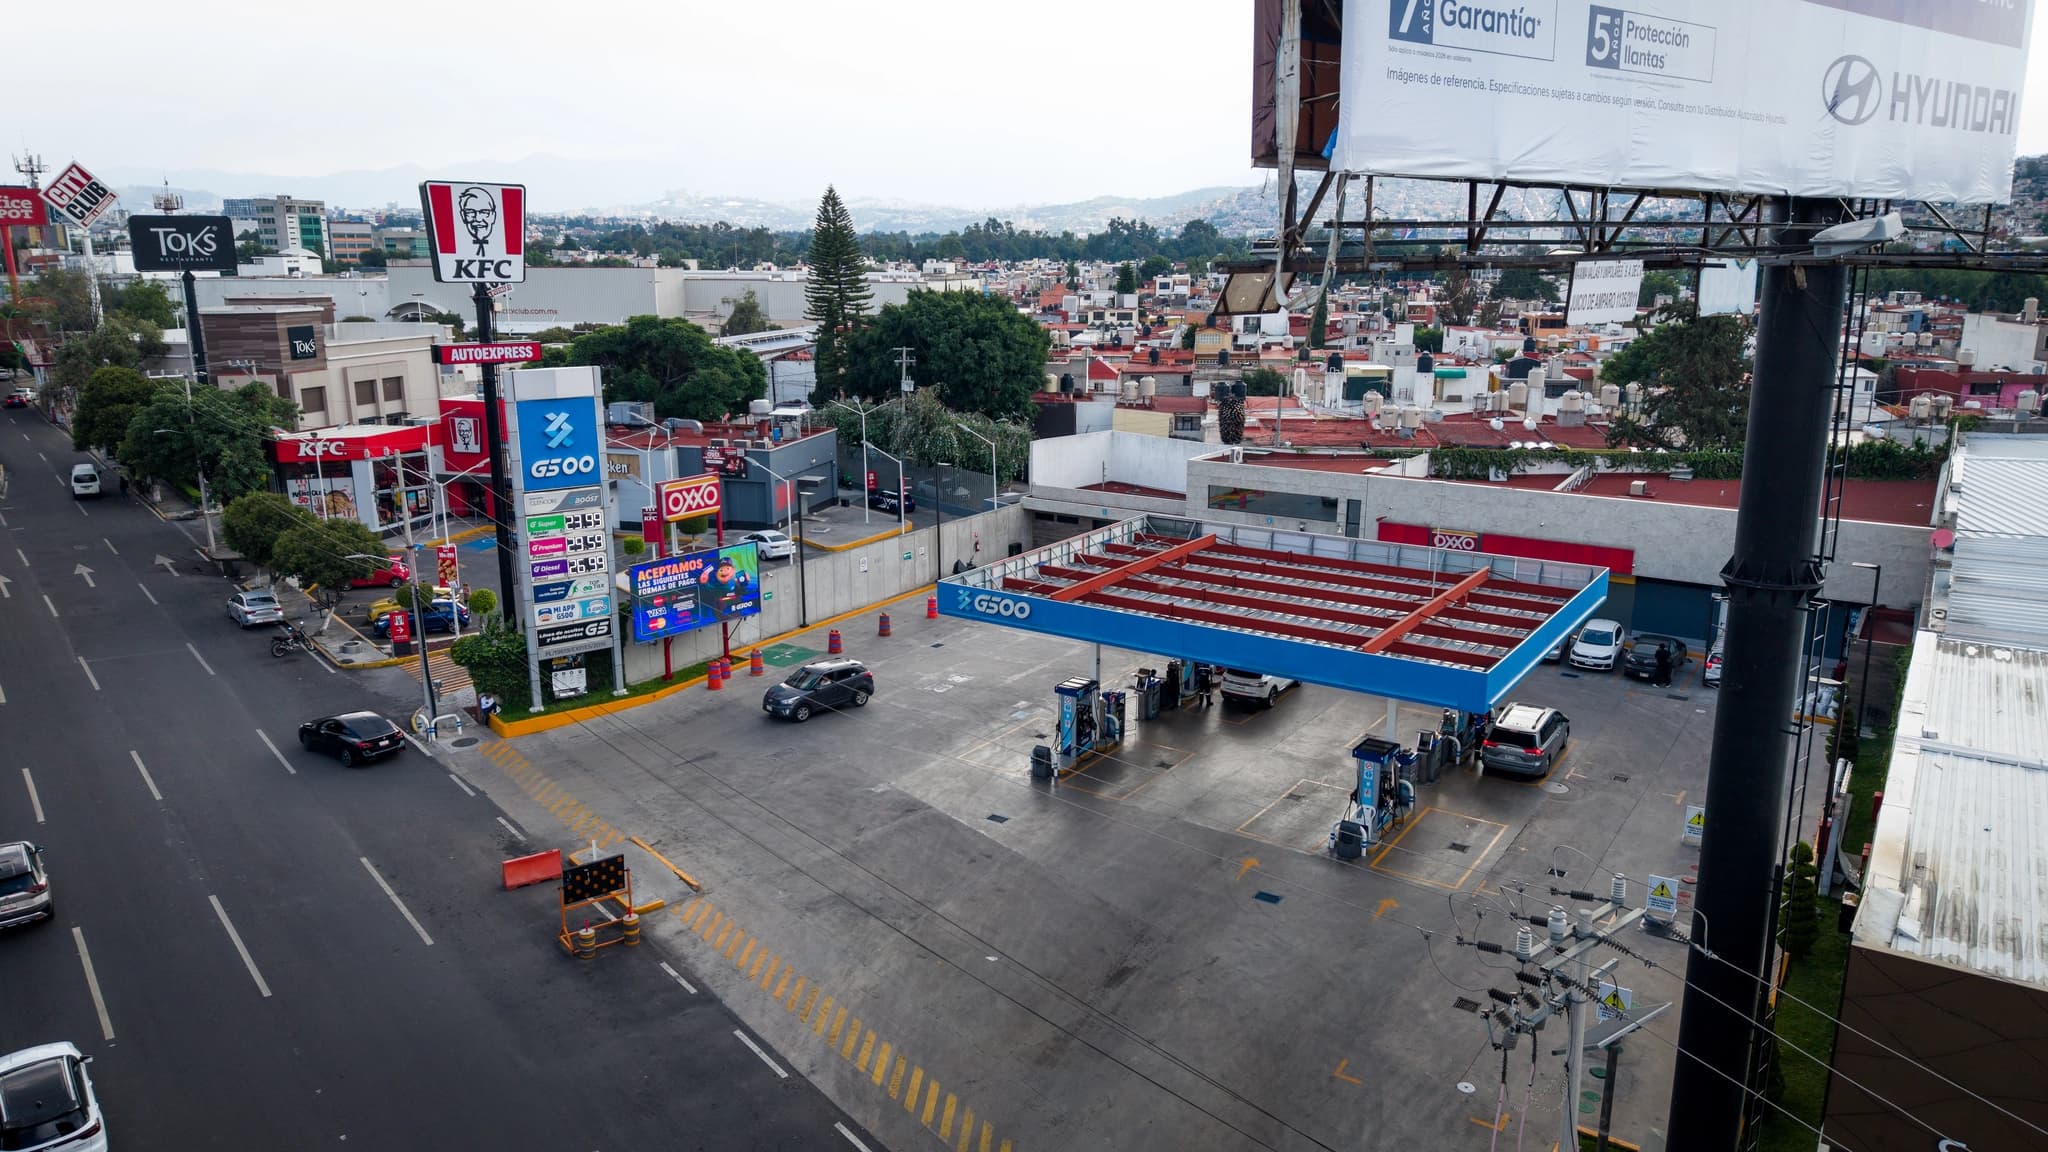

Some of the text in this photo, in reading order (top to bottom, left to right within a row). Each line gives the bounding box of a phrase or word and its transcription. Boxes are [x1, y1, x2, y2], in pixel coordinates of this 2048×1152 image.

[1592, 14, 1611, 61] 5
[1626, 20, 1690, 48] Protección
[1387, 67, 1428, 85] Imágenes
[1430, 72, 1441, 85] de
[1443, 73, 1487, 91] referencia.
[1489, 79, 1549, 98] Especificaciones
[1551, 87, 1575, 101] sujetas
[1577, 92, 1581, 100] a
[1582, 90, 1611, 105] cambios
[1612, 95, 1632, 109] según
[1657, 98, 1684, 113] Consulta
[1685, 105, 1696, 114] con
[1889, 72, 2016, 135] HYUNDAI
[48, 166, 89, 206] CITY
[66, 181, 108, 220] CLUB
[452, 260, 512, 279] KFC
[451, 345, 533, 361] AUTOEXPRESS
[297, 441, 345, 456] KFC
[531, 455, 595, 478] G500
[668, 484, 718, 513] OXXO
[1434, 535, 1475, 550] OXXO
[637, 572, 689, 589] LAS SIGUIENTES
[638, 558, 703, 582] ACEPTAMOS
[638, 585, 667, 596] FORMAS
[668, 582, 676, 590] DE
[553, 604, 575, 614] MI APP
[647, 607, 667, 617] VISA
[974, 594, 1031, 619] G500
[585, 621, 609, 636] G5
